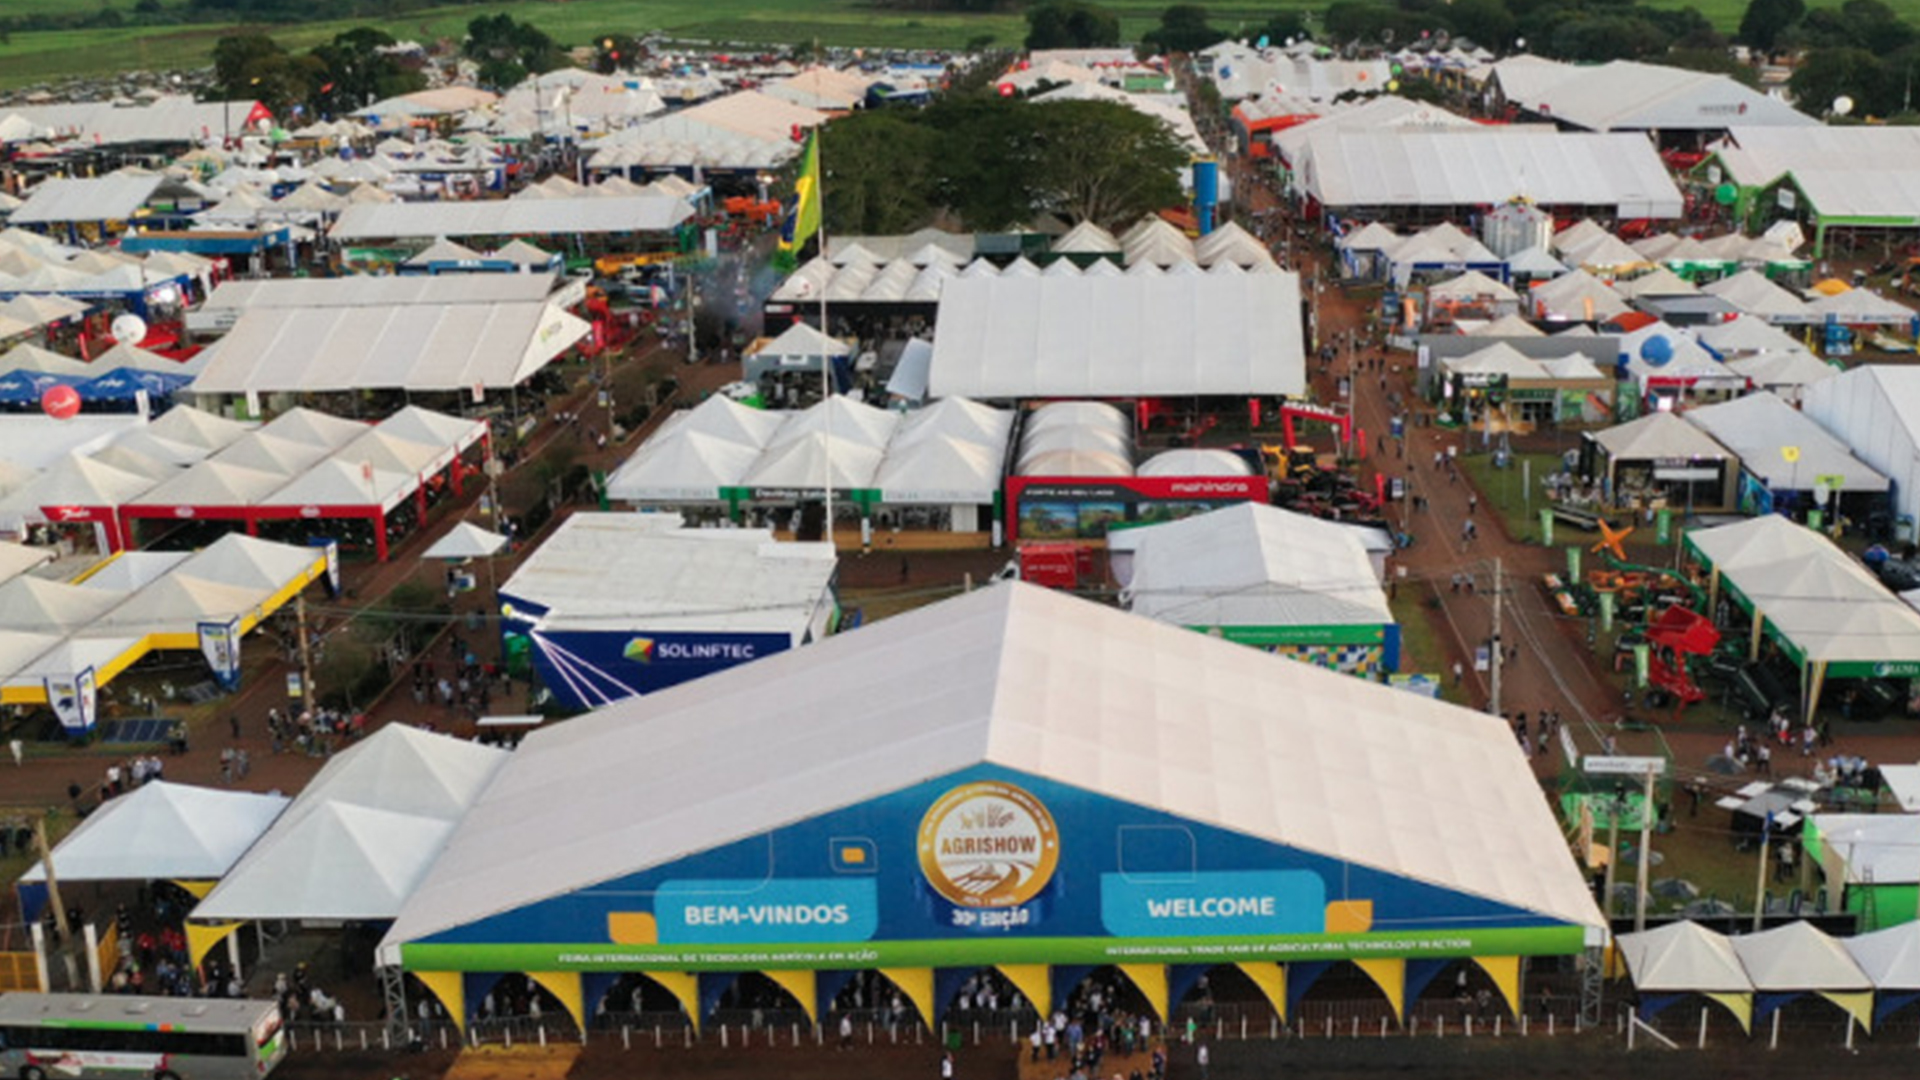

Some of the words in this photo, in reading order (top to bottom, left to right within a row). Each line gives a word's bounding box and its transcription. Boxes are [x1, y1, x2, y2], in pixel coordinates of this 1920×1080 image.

[1170, 482, 1248, 493] mahindra
[658, 643, 754, 658] SOLINFTEC
[941, 835, 1037, 855] AGRISHOW
[684, 904, 849, 925] BEM-VINDOS
[1147, 897, 1276, 917] WELCOME
[980, 905, 1029, 931] EDIÇÃO
[1431, 938, 1471, 949] ACTION
[558, 953, 591, 963] FEIRA
[592, 953, 680, 963] INTERNACIONAL
[847, 948, 878, 963] AÇÃO
